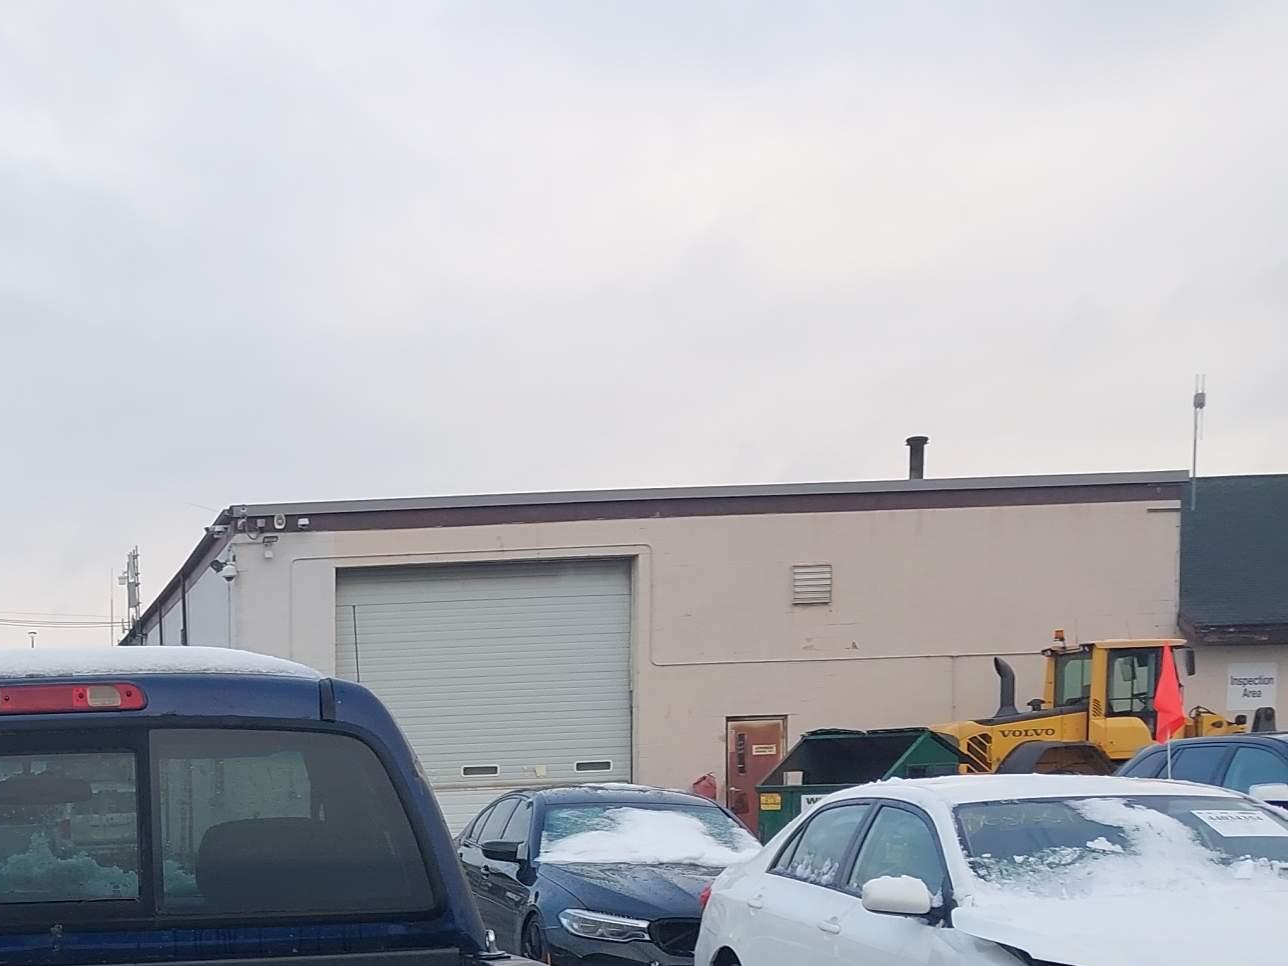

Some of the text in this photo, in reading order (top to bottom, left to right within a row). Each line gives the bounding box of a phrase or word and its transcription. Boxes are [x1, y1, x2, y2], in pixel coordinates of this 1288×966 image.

[1230, 675, 1274, 687] Inspection
[1242, 688, 1263, 698] Area
[999, 728, 1055, 738] VOLVO
